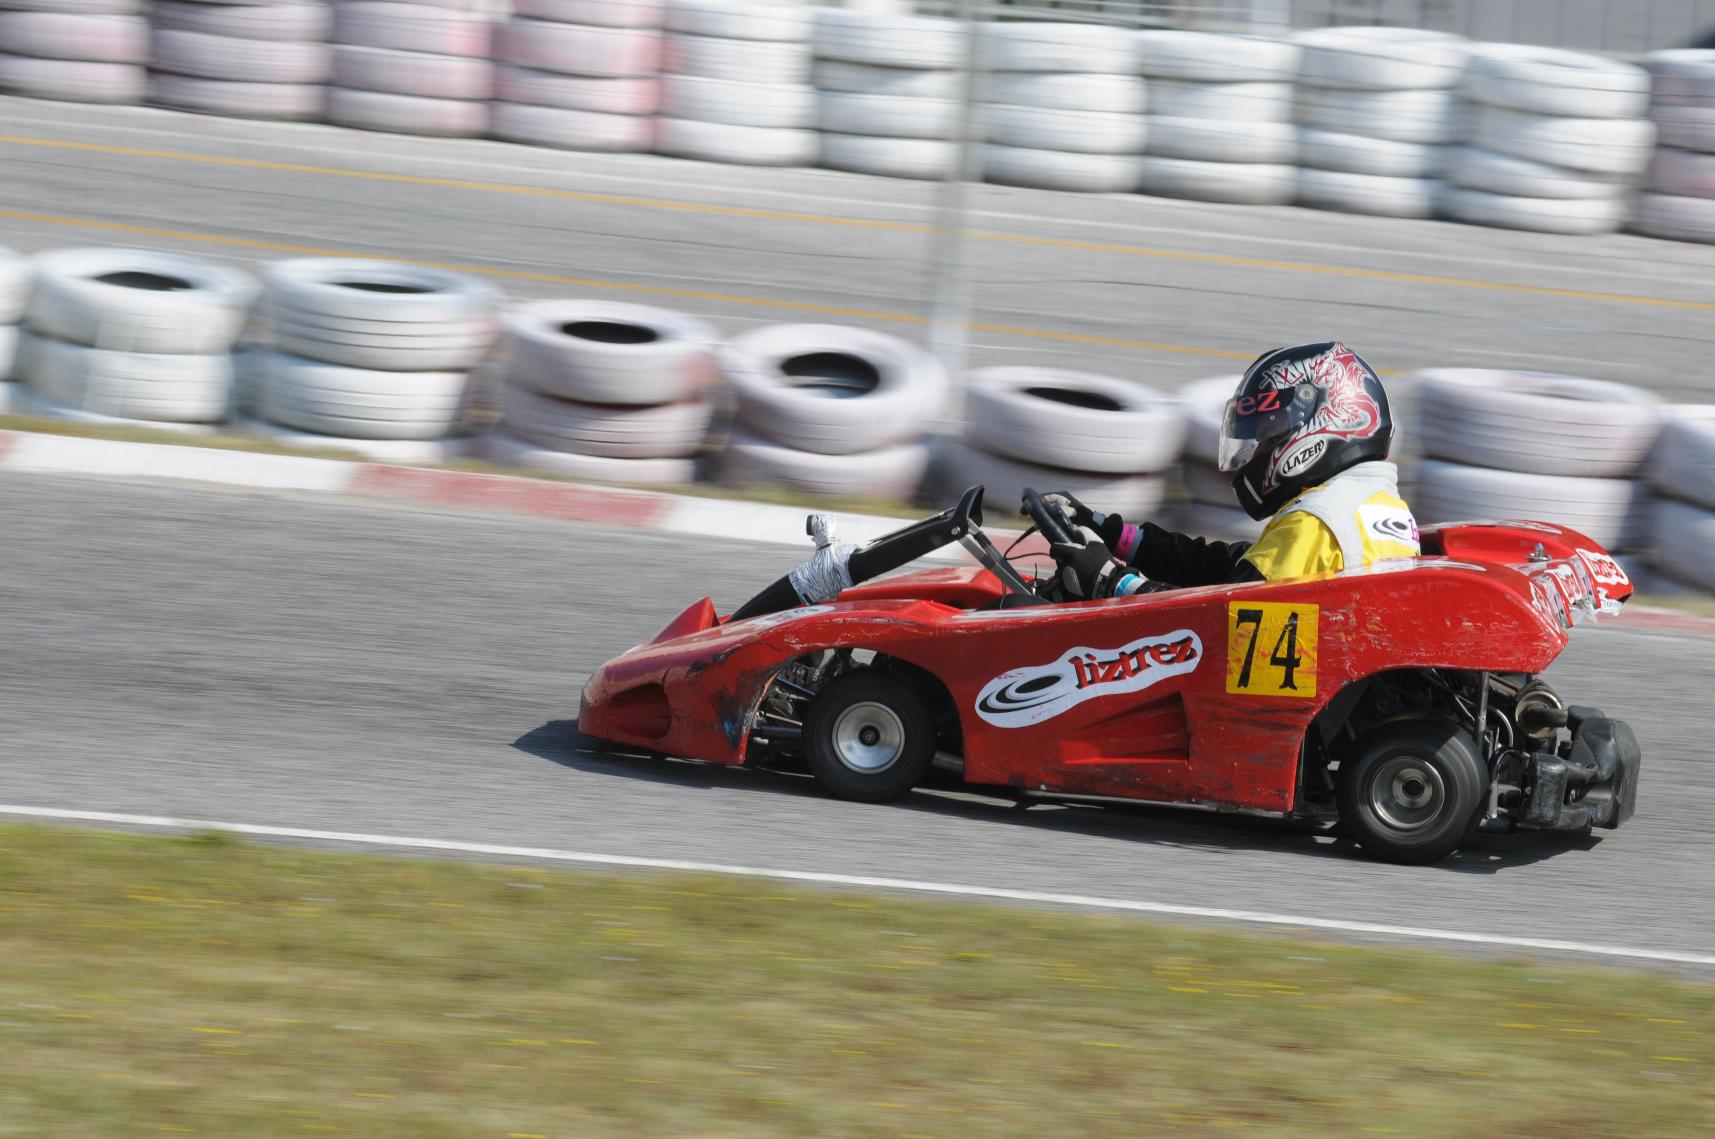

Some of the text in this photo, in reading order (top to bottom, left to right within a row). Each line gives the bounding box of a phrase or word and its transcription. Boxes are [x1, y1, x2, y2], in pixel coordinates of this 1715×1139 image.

[1286, 442, 1322, 471] LAZER
[1069, 636, 1198, 690] liztrez
[1235, 609, 1302, 690] 74
